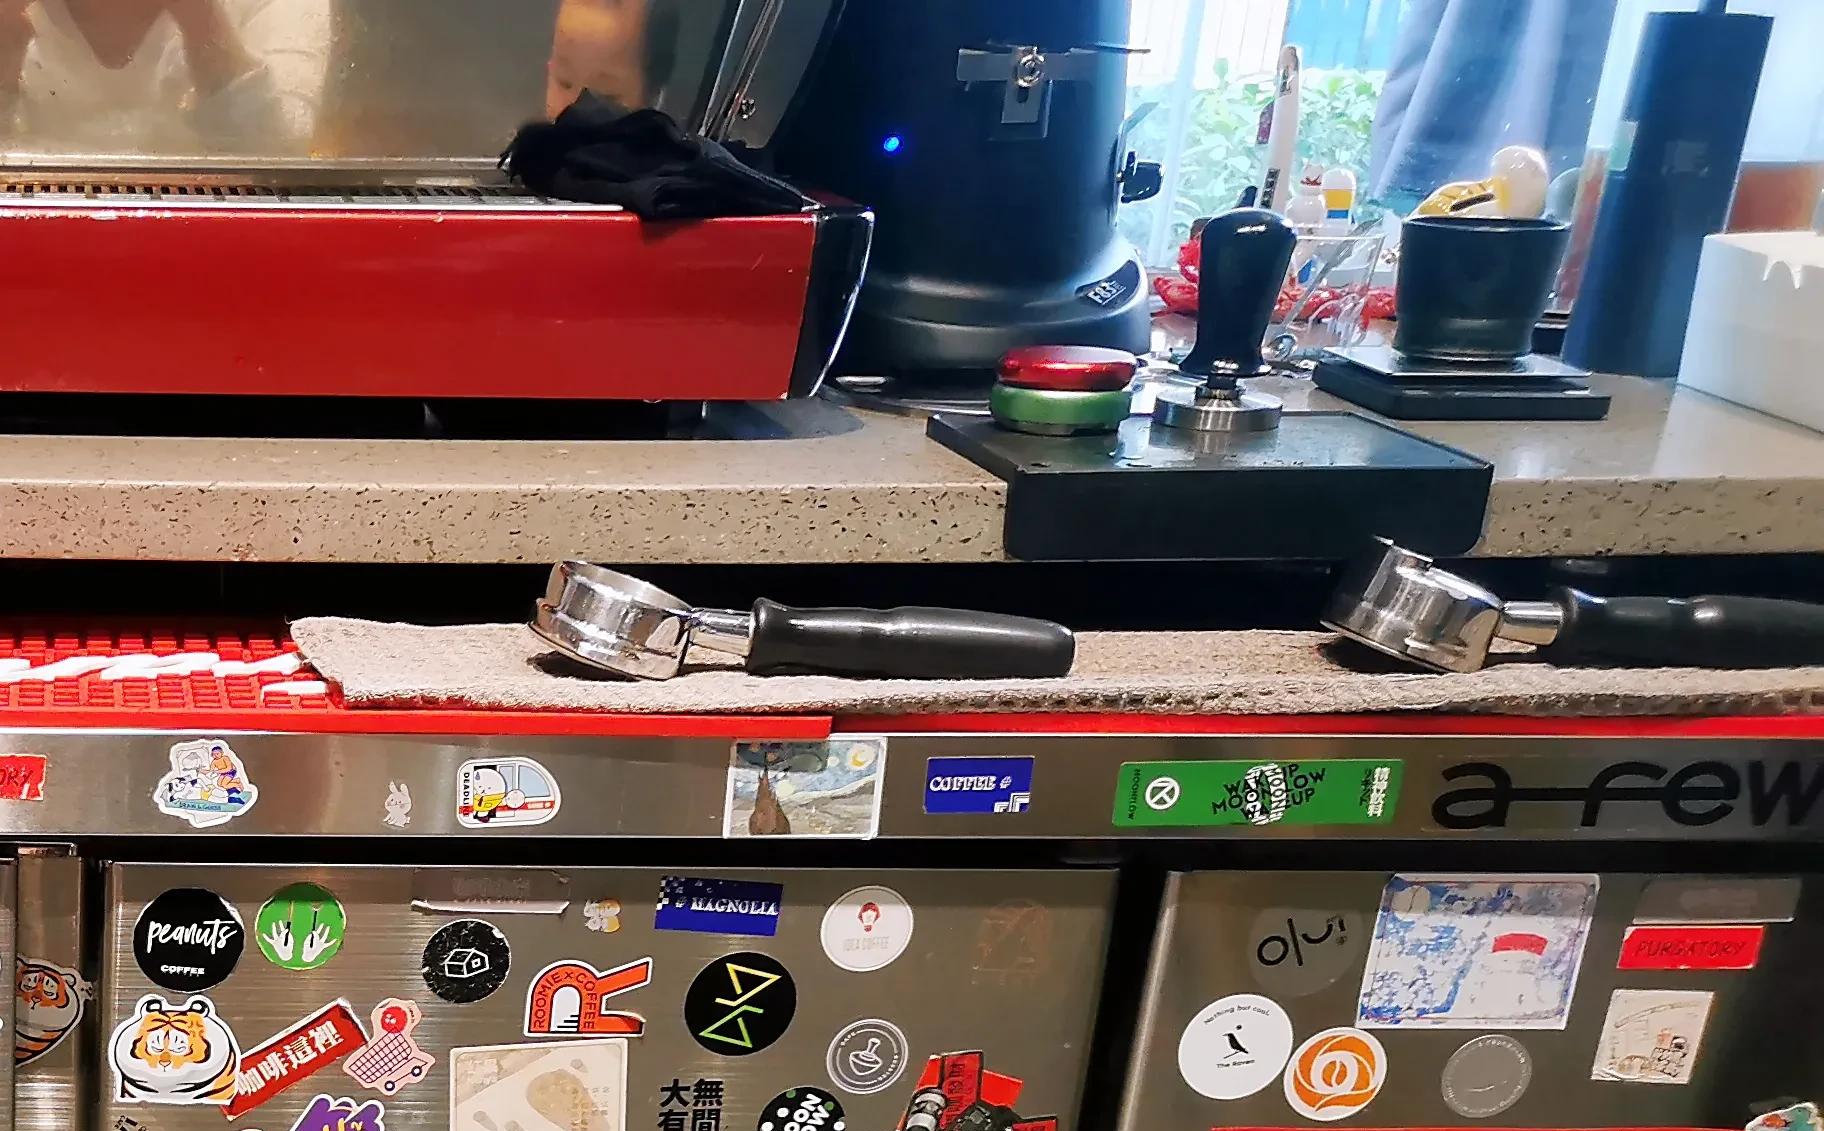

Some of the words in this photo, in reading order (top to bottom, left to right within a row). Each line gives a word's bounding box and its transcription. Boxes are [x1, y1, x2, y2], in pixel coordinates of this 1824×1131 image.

[930, 776, 995, 791] COFFEE
[691, 897, 778, 916] MAGNOLIA
[147, 919, 237, 955] peanuts
[1636, 939, 1745, 958] PURGATORY
[161, 965, 205, 976] COFFEE
[532, 973, 560, 1030] ROOMIE
[576, 973, 598, 1030] COFFEE
[660, 1079, 724, 1107] 大無
